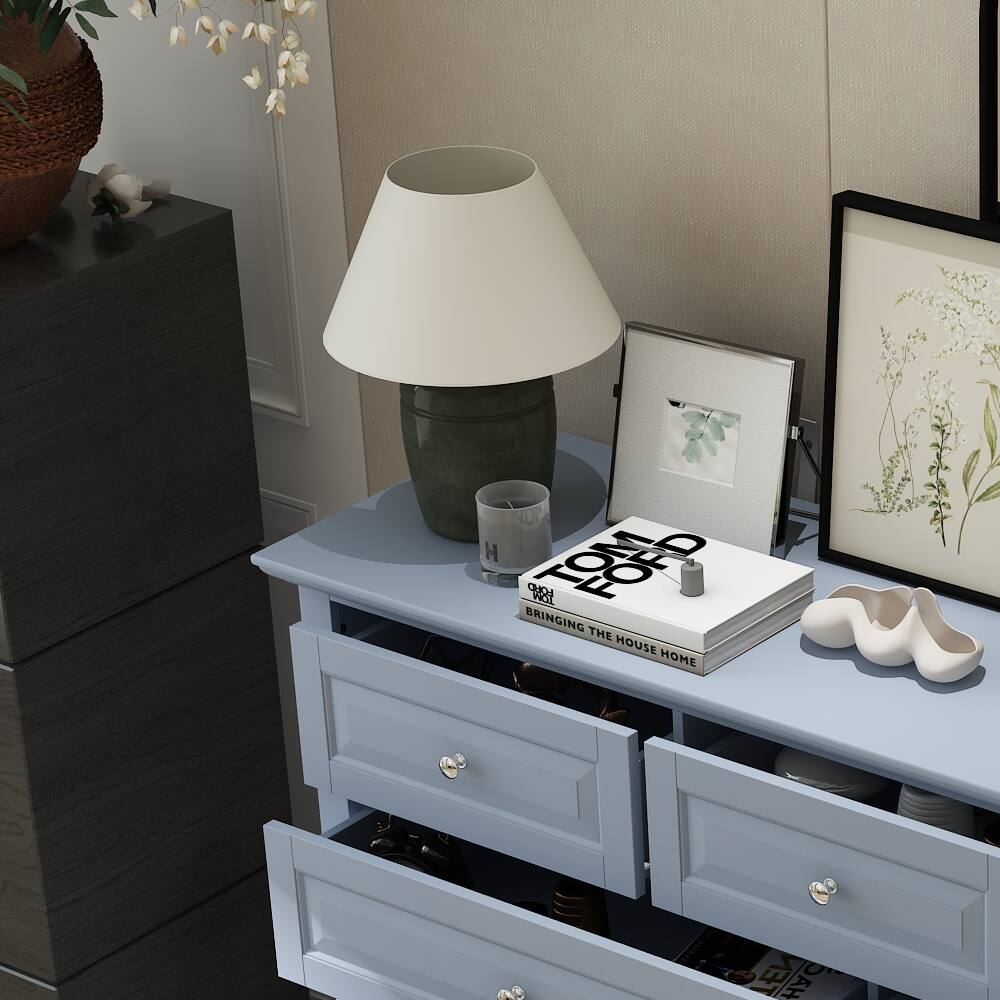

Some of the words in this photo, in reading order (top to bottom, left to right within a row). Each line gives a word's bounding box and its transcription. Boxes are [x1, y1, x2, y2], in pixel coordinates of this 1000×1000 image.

[533, 530, 656, 584] TOM
[573, 533, 707, 599] FORD
[528, 583, 553, 598] FORD
[533, 590, 555, 606] TOM
[525, 606, 585, 633] BRINGING
[588, 625, 613, 641] THE
[616, 634, 657, 655] HOUSE
[660, 650, 697, 668] HOME
